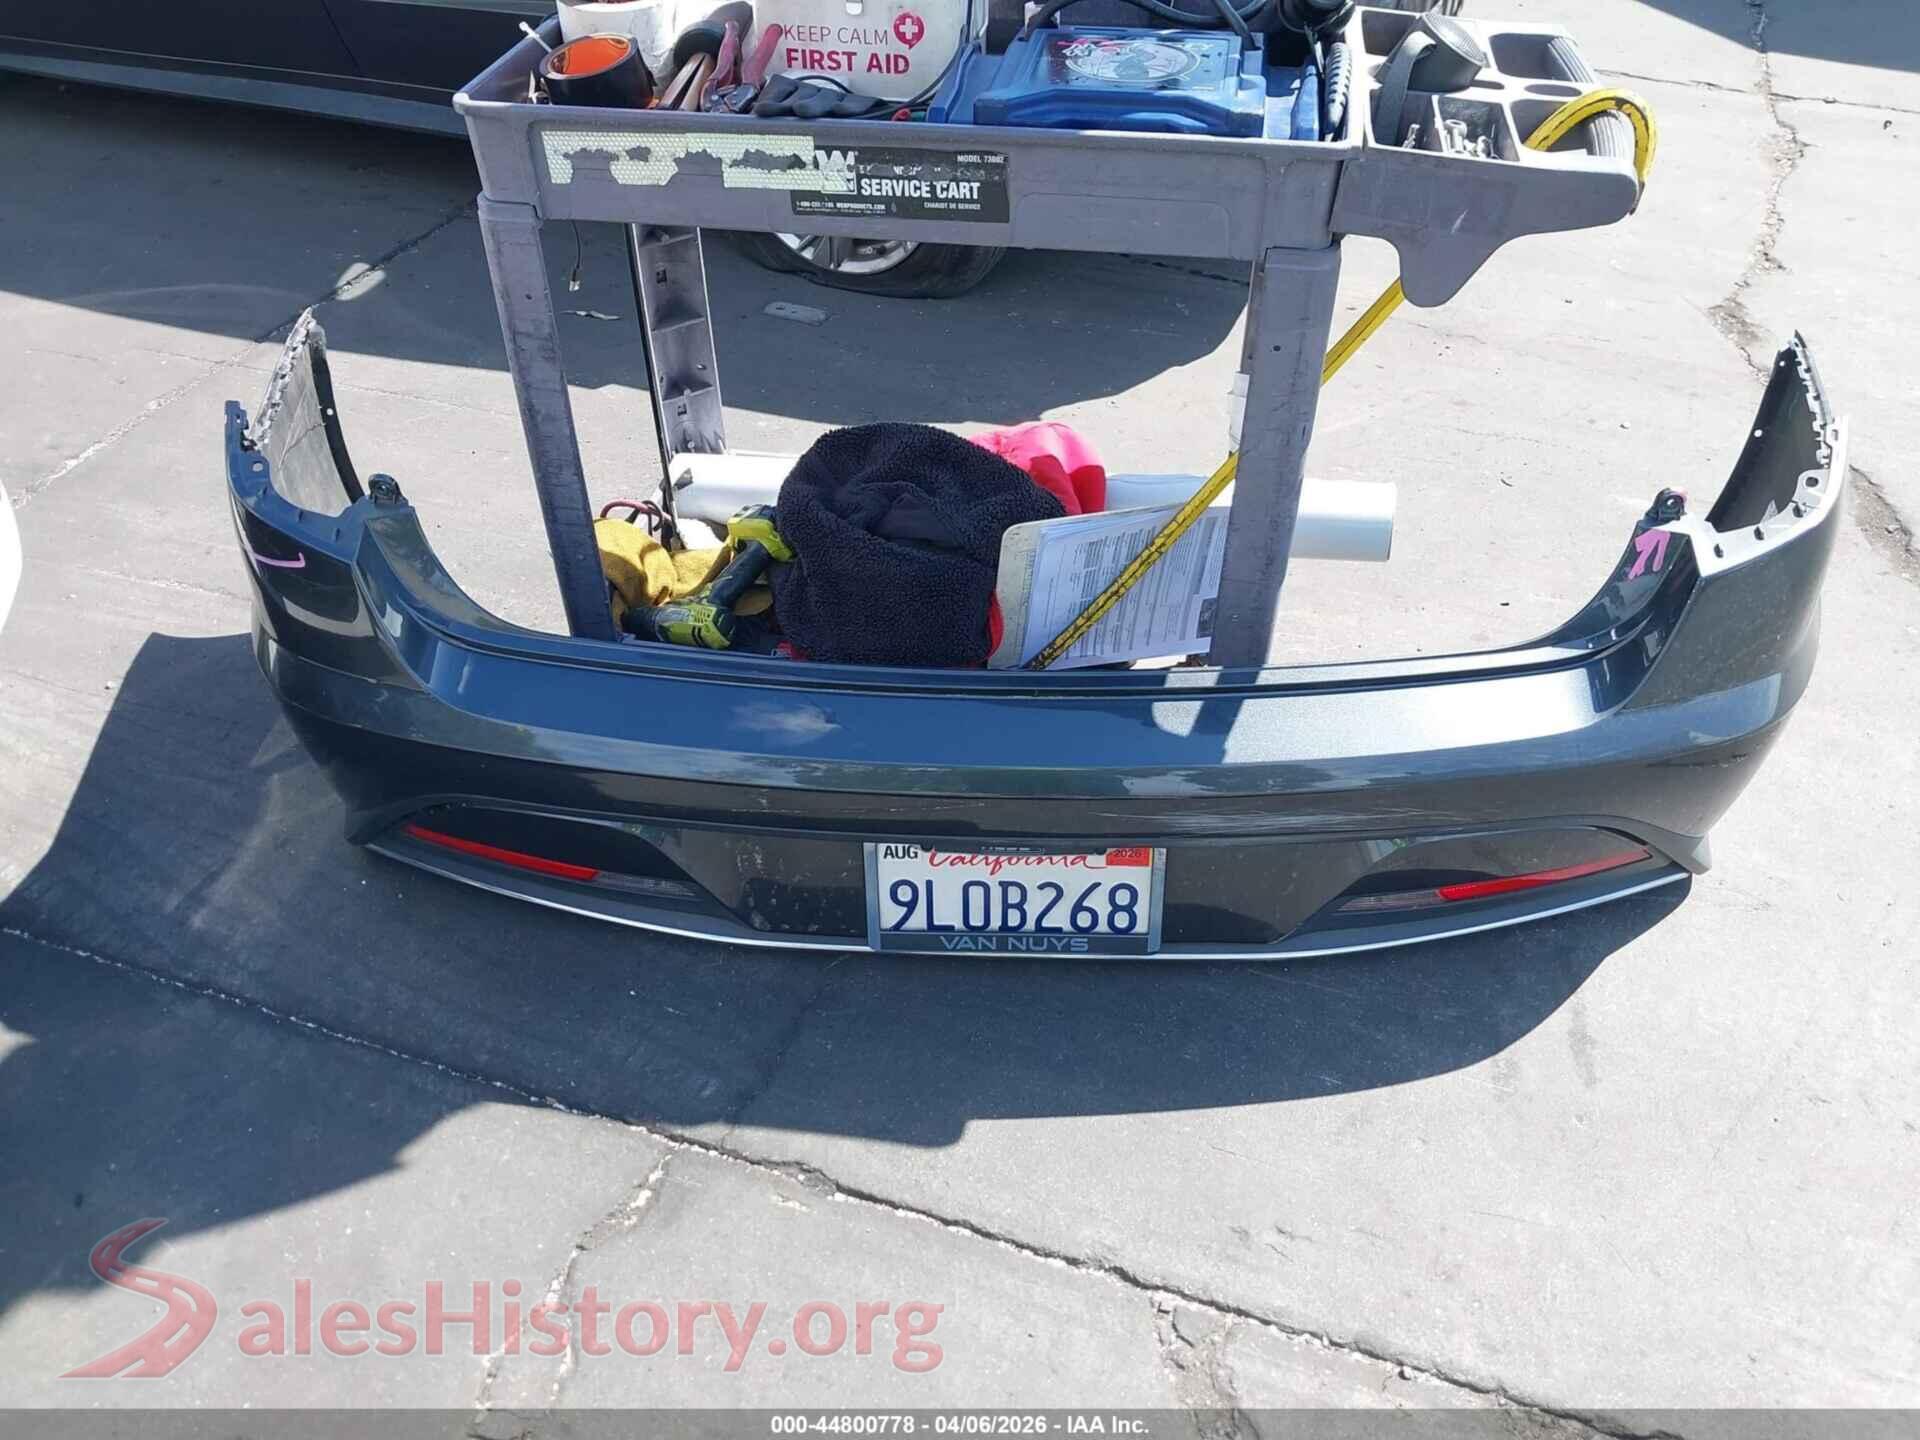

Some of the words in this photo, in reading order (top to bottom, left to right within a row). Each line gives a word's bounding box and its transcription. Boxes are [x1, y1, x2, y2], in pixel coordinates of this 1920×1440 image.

[783, 24, 831, 42] KEEP
[837, 27, 888, 45] CALM
[786, 48, 857, 71] FIRST
[867, 53, 910, 74] AID
[957, 154, 981, 163] MODEL
[860, 178, 931, 198] SERVICE
[935, 181, 981, 199] CART
[923, 201, 947, 209] CHARIOT
[882, 844, 919, 860] AUG
[928, 848, 1107, 876] California
[940, 935, 997, 950] VAN
[1008, 936, 1089, 951] NUYS
